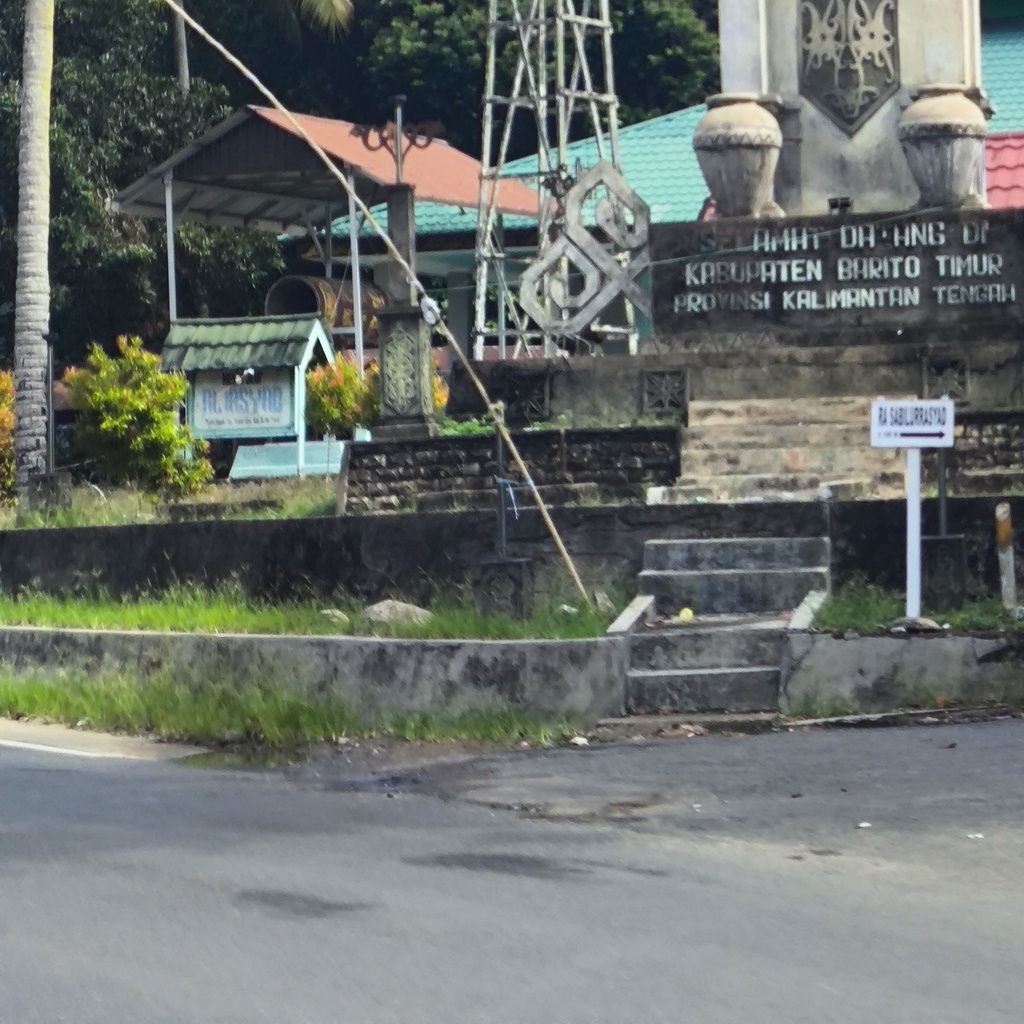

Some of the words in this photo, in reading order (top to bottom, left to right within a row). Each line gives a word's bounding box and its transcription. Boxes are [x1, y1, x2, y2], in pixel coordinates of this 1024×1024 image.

[700, 226, 820, 253] SAMAT
[840, 221, 946, 249] DAANG
[962, 219, 990, 245] DI
[685, 258, 823, 286] KABUPATEN
[838, 255, 921, 280] BARITO
[935, 253, 1003, 278] TIMUR
[673, 289, 771, 314] PROVINSI
[782, 286, 920, 311] KALIMANTAN
[932, 283, 1016, 306] TENGAH
